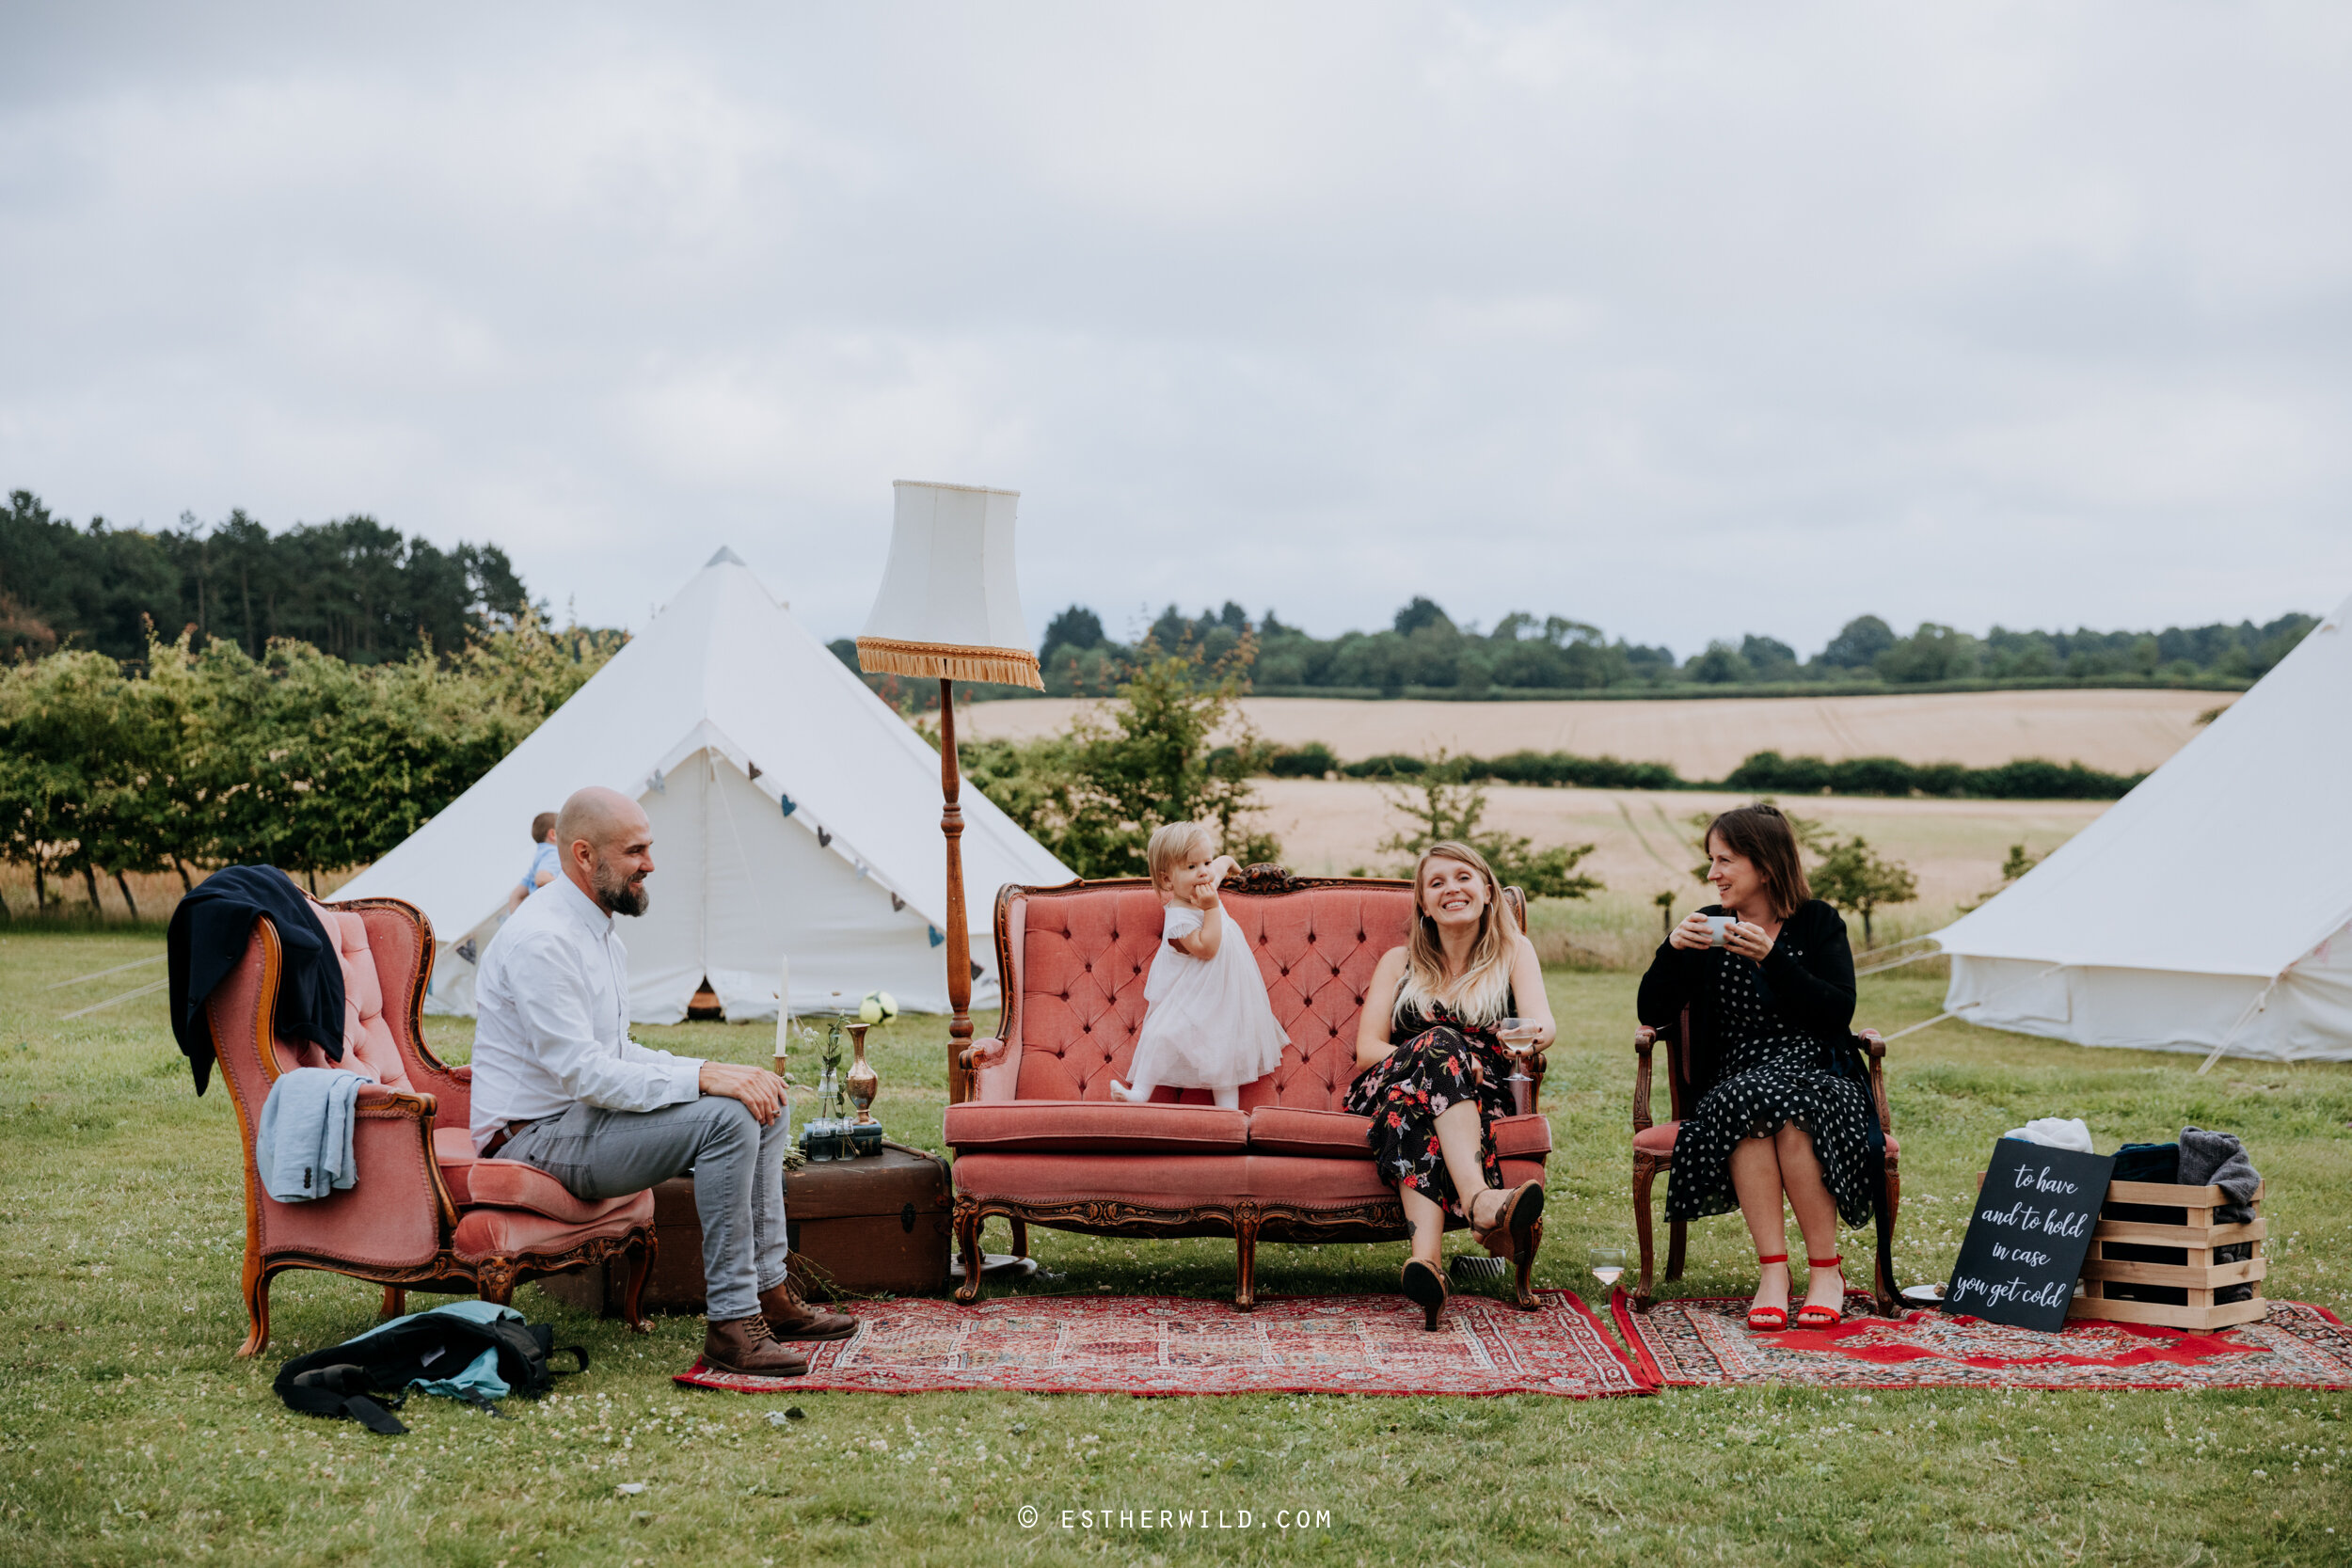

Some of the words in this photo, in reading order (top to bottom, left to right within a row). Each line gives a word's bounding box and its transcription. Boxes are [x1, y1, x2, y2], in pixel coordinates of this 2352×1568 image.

[2014, 1164, 2035, 1188] to
[2036, 1166, 2078, 1194] have
[1981, 1202, 2023, 1226] and
[2021, 1206, 2042, 1230] to
[2043, 1209, 2089, 1238] hold
[1992, 1242, 2010, 1260] in
[2011, 1248, 2051, 1267] case
[1952, 1276, 1989, 1302] you
[1986, 1276, 2026, 1307] get
[2023, 1282, 2067, 1308] cold
